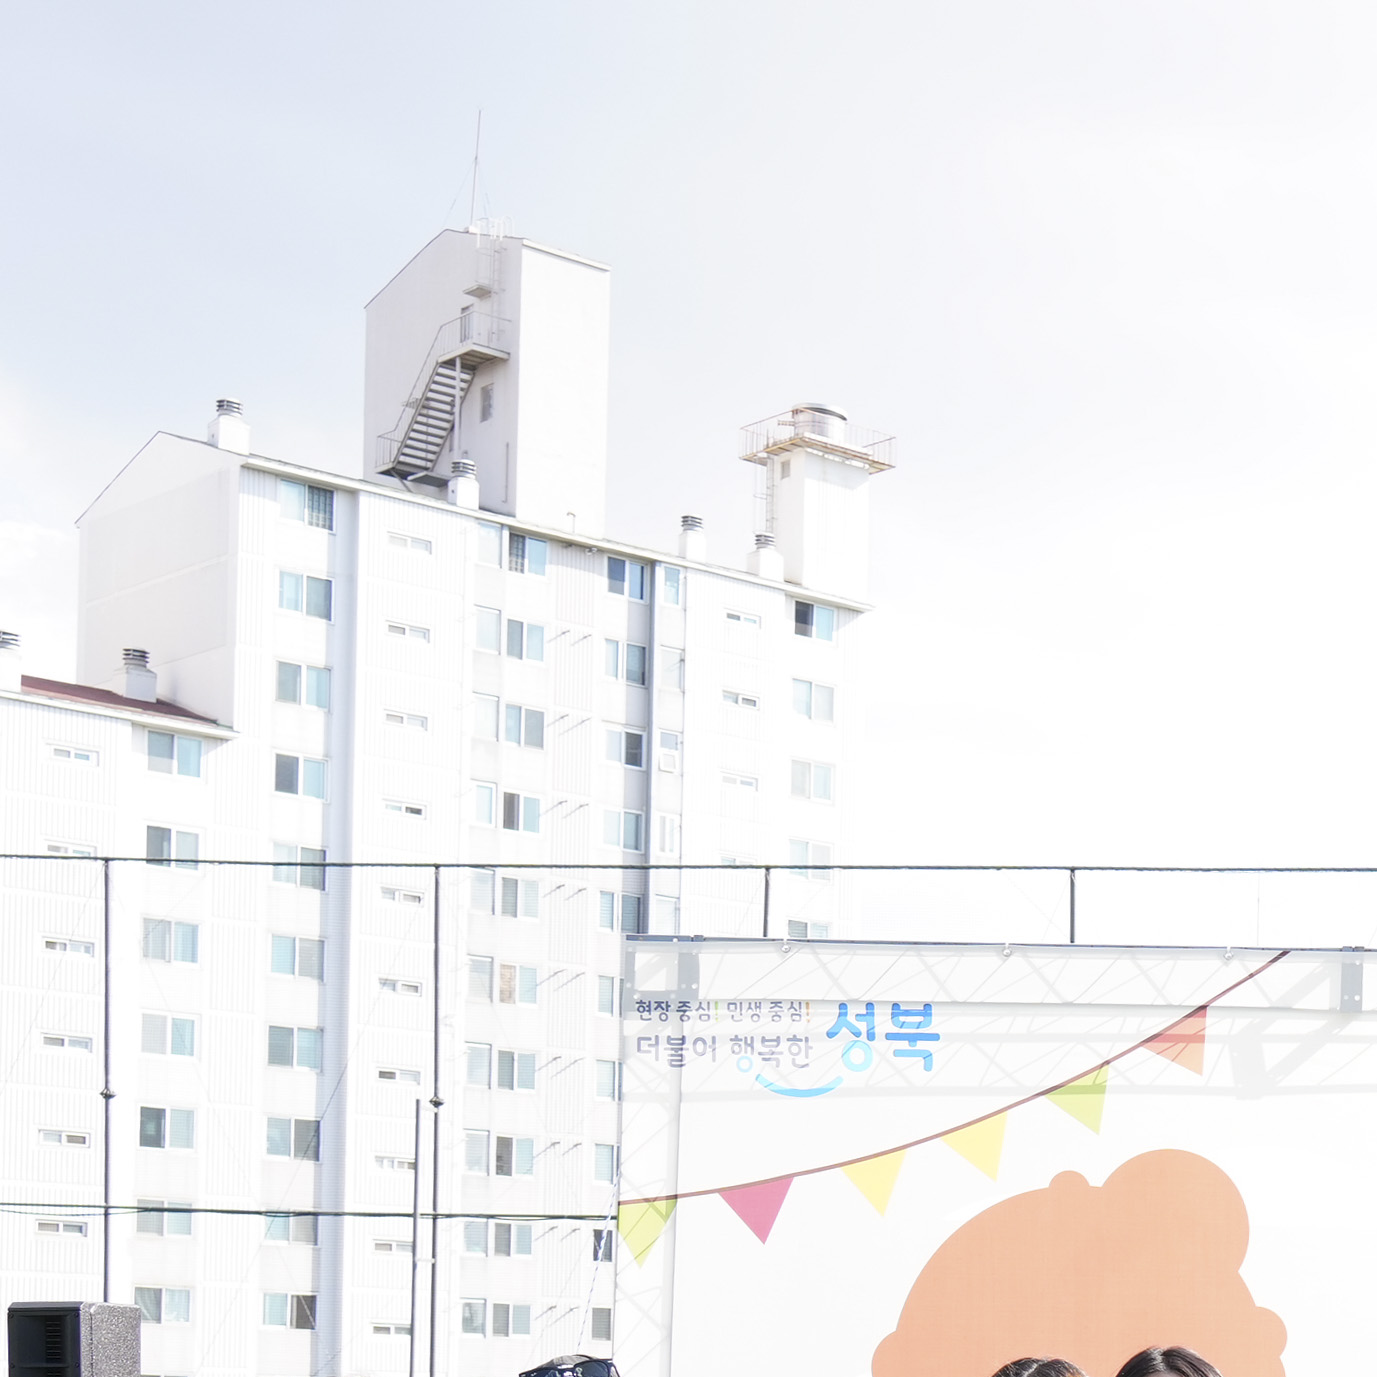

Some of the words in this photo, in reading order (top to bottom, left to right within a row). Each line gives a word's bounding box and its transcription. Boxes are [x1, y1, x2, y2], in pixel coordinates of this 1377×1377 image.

[635, 1000, 671, 1023] 현장
[676, 1000, 719, 1023] 중심!
[727, 1001, 762, 1023] 민생
[767, 1001, 811, 1023] 중심!
[636, 1034, 717, 1069] 더불어
[729, 1034, 813, 1072] 행복한
[826, 1002, 941, 1072] 성북
